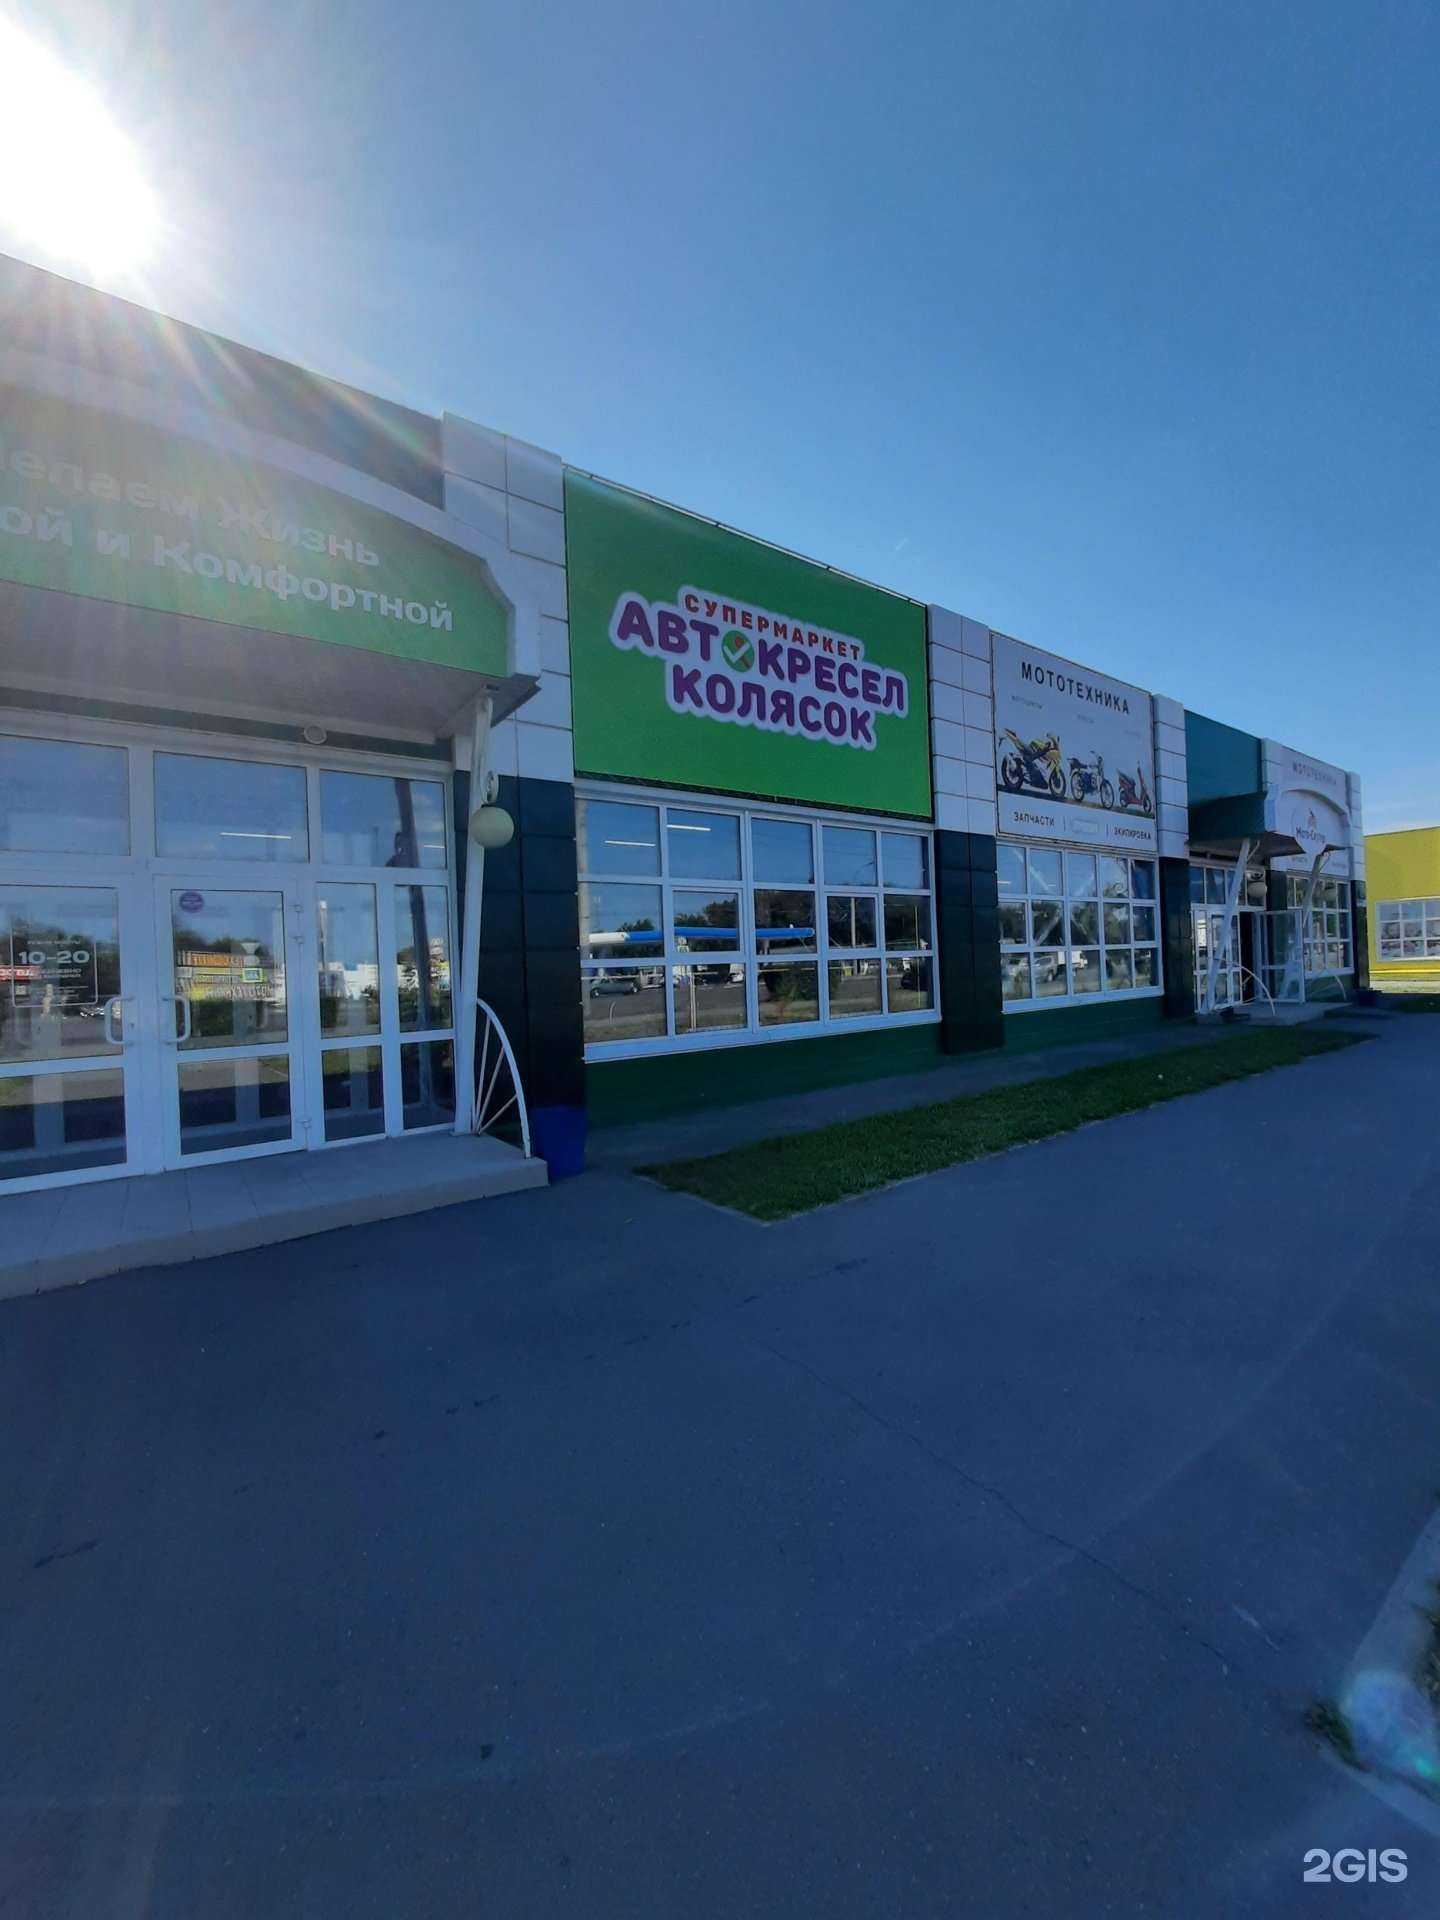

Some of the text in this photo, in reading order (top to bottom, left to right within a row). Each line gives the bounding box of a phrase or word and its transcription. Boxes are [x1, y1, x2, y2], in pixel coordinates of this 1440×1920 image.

[0, 441, 200, 521] елаем
[97, 528, 130, 561] и
[153, 534, 454, 632] Комфортной
[684, 593, 862, 661] СУПЕРМАРКЕТ
[672, 664, 872, 743] КОЛЯСОК
[1021, 661, 1130, 715] МОТОТЕХНИКА
[1013, 811, 1055, 826] ЗАПЧАСТИ
[19, 950, 90, 965] 10-20
